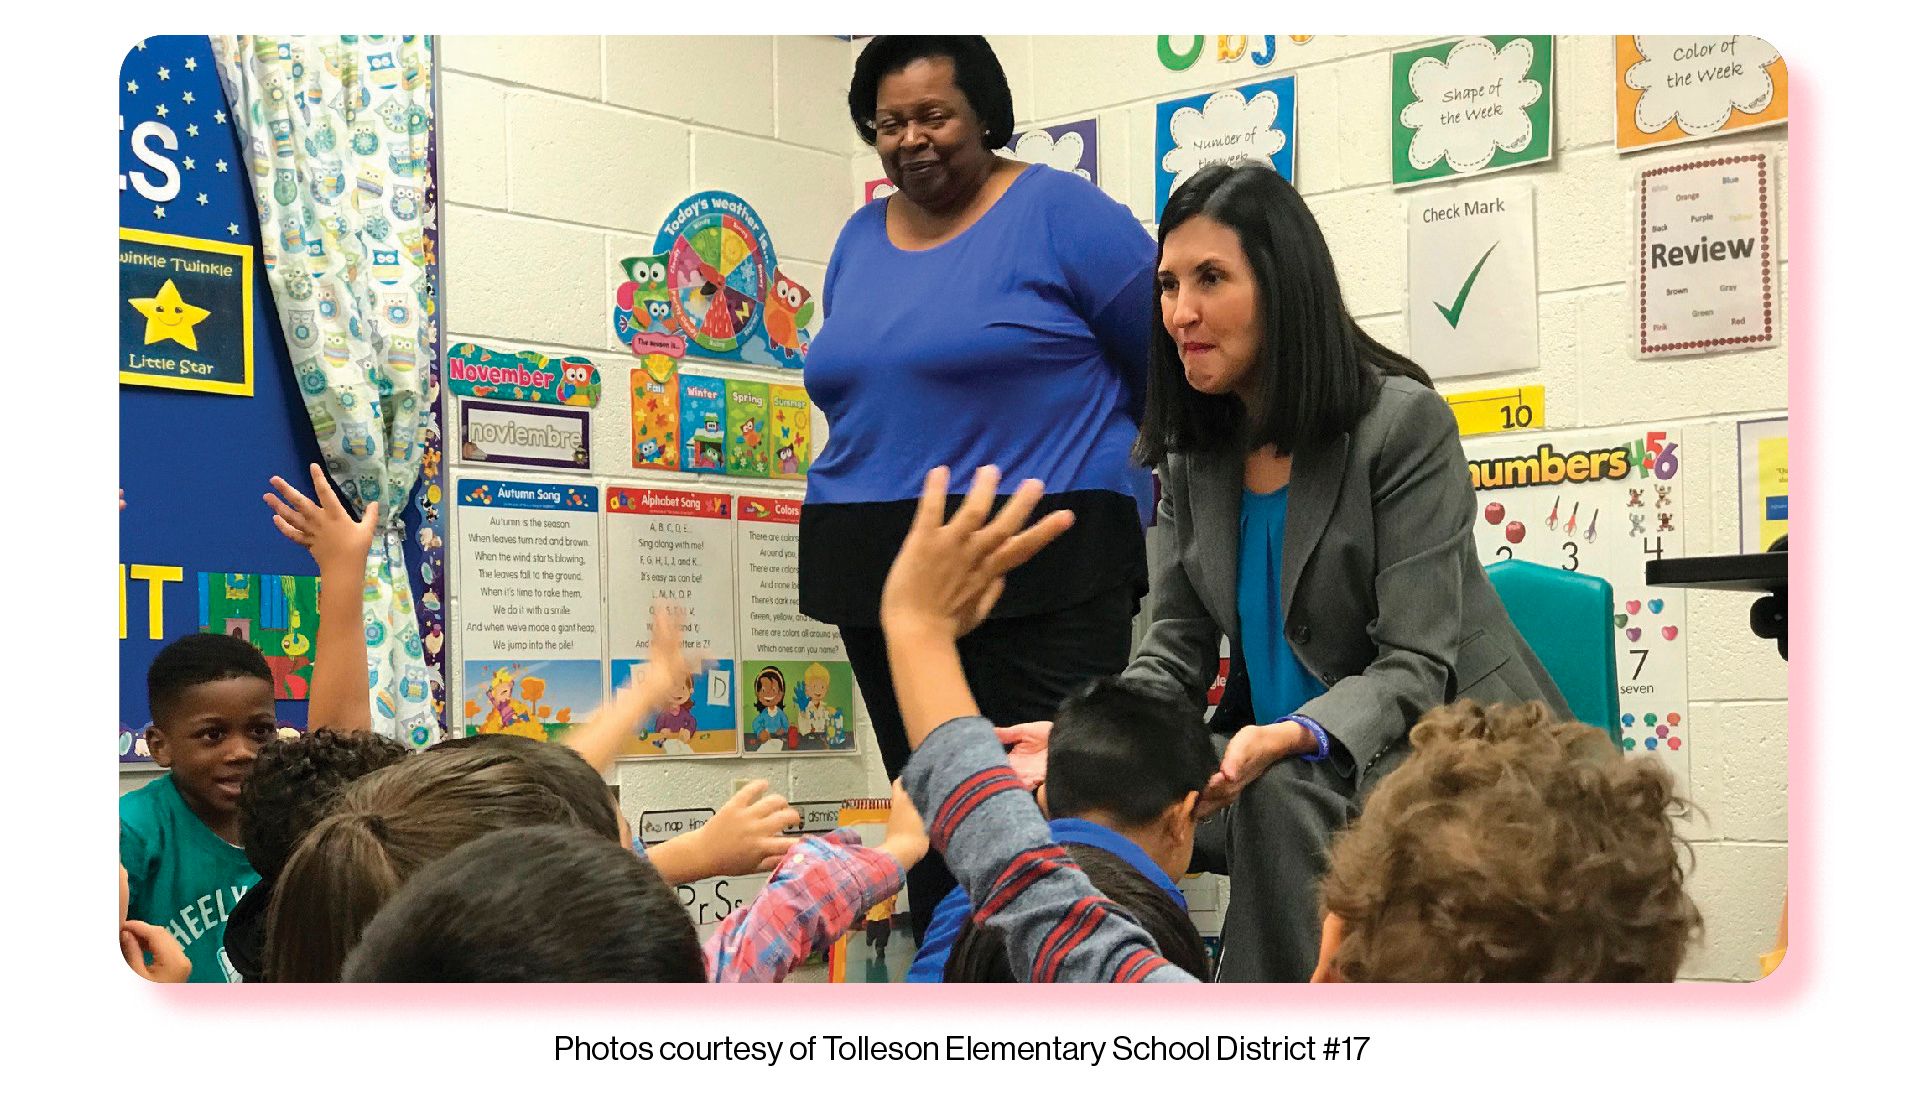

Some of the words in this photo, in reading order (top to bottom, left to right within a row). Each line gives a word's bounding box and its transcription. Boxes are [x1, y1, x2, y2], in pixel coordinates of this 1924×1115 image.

[1157, 35, 1313, 71] Obj
[1673, 43, 1716, 61] Color
[1721, 35, 1738, 55] of
[1667, 73, 1691, 88] the
[1697, 62, 1743, 83] Week
[1442, 86, 1485, 103] Shape
[1488, 78, 1503, 97] of
[1440, 111, 1461, 126] the
[1465, 103, 1504, 121] Week
[1193, 132, 1242, 150] Number
[1244, 126, 1257, 144] of
[119, 115, 181, 201] S
[1722, 175, 1739, 185] Blue
[1675, 191, 1700, 202] Orange
[664, 198, 709, 236] Today's
[711, 198, 760, 231] Weather
[1423, 203, 1460, 225] Check
[1464, 198, 1505, 217] Mark
[1690, 212, 1714, 223] Purple
[1652, 223, 1668, 233] Black
[1651, 236, 1755, 270] Review
[119, 250, 166, 267] winkle
[170, 258, 233, 277] Twinkle
[1666, 286, 1689, 297] Brown
[1653, 323, 1668, 331] Pink
[1731, 317, 1746, 326] Red
[638, 337, 648, 346] The
[129, 353, 175, 370] Little
[180, 359, 214, 375] Star
[450, 358, 554, 389] November
[646, 382, 665, 394] Fall
[687, 386, 718, 399] Winter
[732, 392, 763, 407] Spring
[773, 396, 806, 409] Summer
[1500, 404, 1533, 429] 10
[470, 421, 583, 449] noviembre
[1468, 445, 1630, 491] numbers
[497, 487, 535, 500] Autumn
[537, 490, 560, 503] Song
[641, 490, 680, 507] Alphabet
[681, 498, 701, 510] Song
[775, 504, 799, 516] Colors
[530, 518, 542, 527] the
[468, 533, 491, 543] When
[492, 534, 517, 544] leaves
[518, 535, 534, 544] turn
[535, 536, 548, 545] red
[548, 536, 564, 546] and
[749, 531, 767, 541] There
[638, 539, 654, 550] Sing
[654, 540, 674, 551] along
[675, 541, 690, 550] with
[1644, 536, 1665, 560] 4
[475, 551, 497, 561] When
[499, 552, 511, 561] the
[513, 553, 530, 562] wind
[678, 558, 690, 566] and
[1562, 542, 1579, 572] 3
[478, 569, 492, 578] The
[494, 569, 518, 579] leaves
[542, 570, 554, 579] the
[749, 563, 768, 573] There
[652, 574, 667, 583] easy
[668, 575, 676, 583] as
[677, 575, 691, 583] can
[760, 581, 773, 589] And
[480, 587, 502, 597] When
[517, 588, 533, 597] time
[535, 588, 542, 597] to
[544, 588, 560, 598] rake
[775, 597, 788, 605] dark
[493, 605, 505, 614] We
[507, 605, 518, 614] do
[519, 605, 524, 614] it
[526, 605, 543, 615] with
[466, 622, 483, 631] And
[484, 622, 504, 631] when
[528, 623, 550, 632] made
[558, 623, 576, 634] giant
[752, 628, 769, 637] There
[493, 640, 505, 650] We
[507, 640, 527, 651] jump
[529, 640, 543, 650] into
[545, 640, 556, 650] the
[757, 644, 777, 653] Which
[807, 647, 818, 655] you
[1630, 650, 1649, 680] 7
[713, 675, 727, 699] D
[1620, 684, 1654, 694] seven
[664, 820, 683, 832] nap
